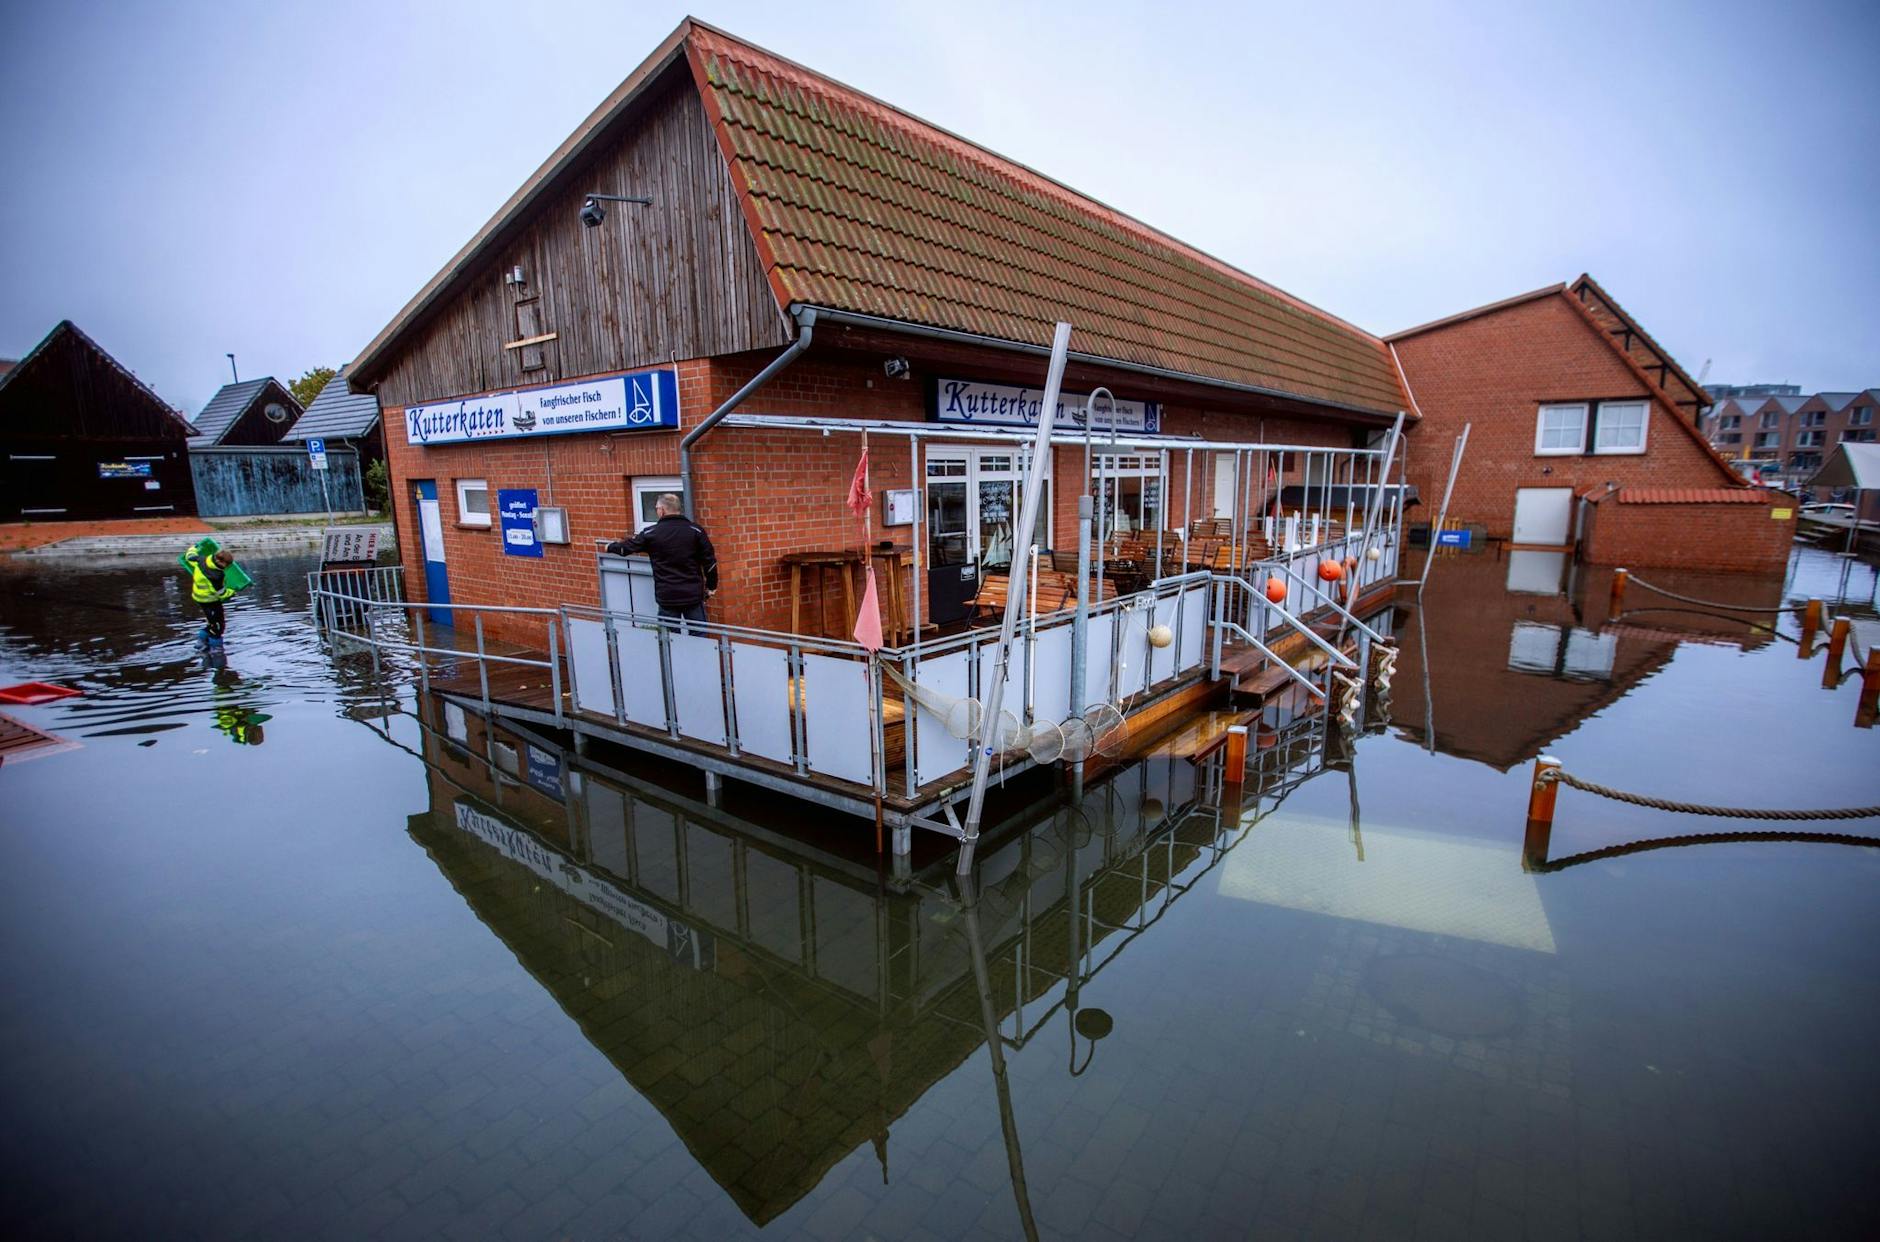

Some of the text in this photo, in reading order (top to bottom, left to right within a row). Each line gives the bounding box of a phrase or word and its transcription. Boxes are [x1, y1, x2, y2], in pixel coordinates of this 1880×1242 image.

[540, 390, 601, 409] Fangfrischer Fisch
[945, 381, 1065, 423] Kutterkan
[409, 400, 505, 441] Kutterkaten
[542, 417, 554, 425] von
[556, 413, 583, 424] unseren
[585, 408, 616, 421] Fischern
[311, 441, 320, 452] P
